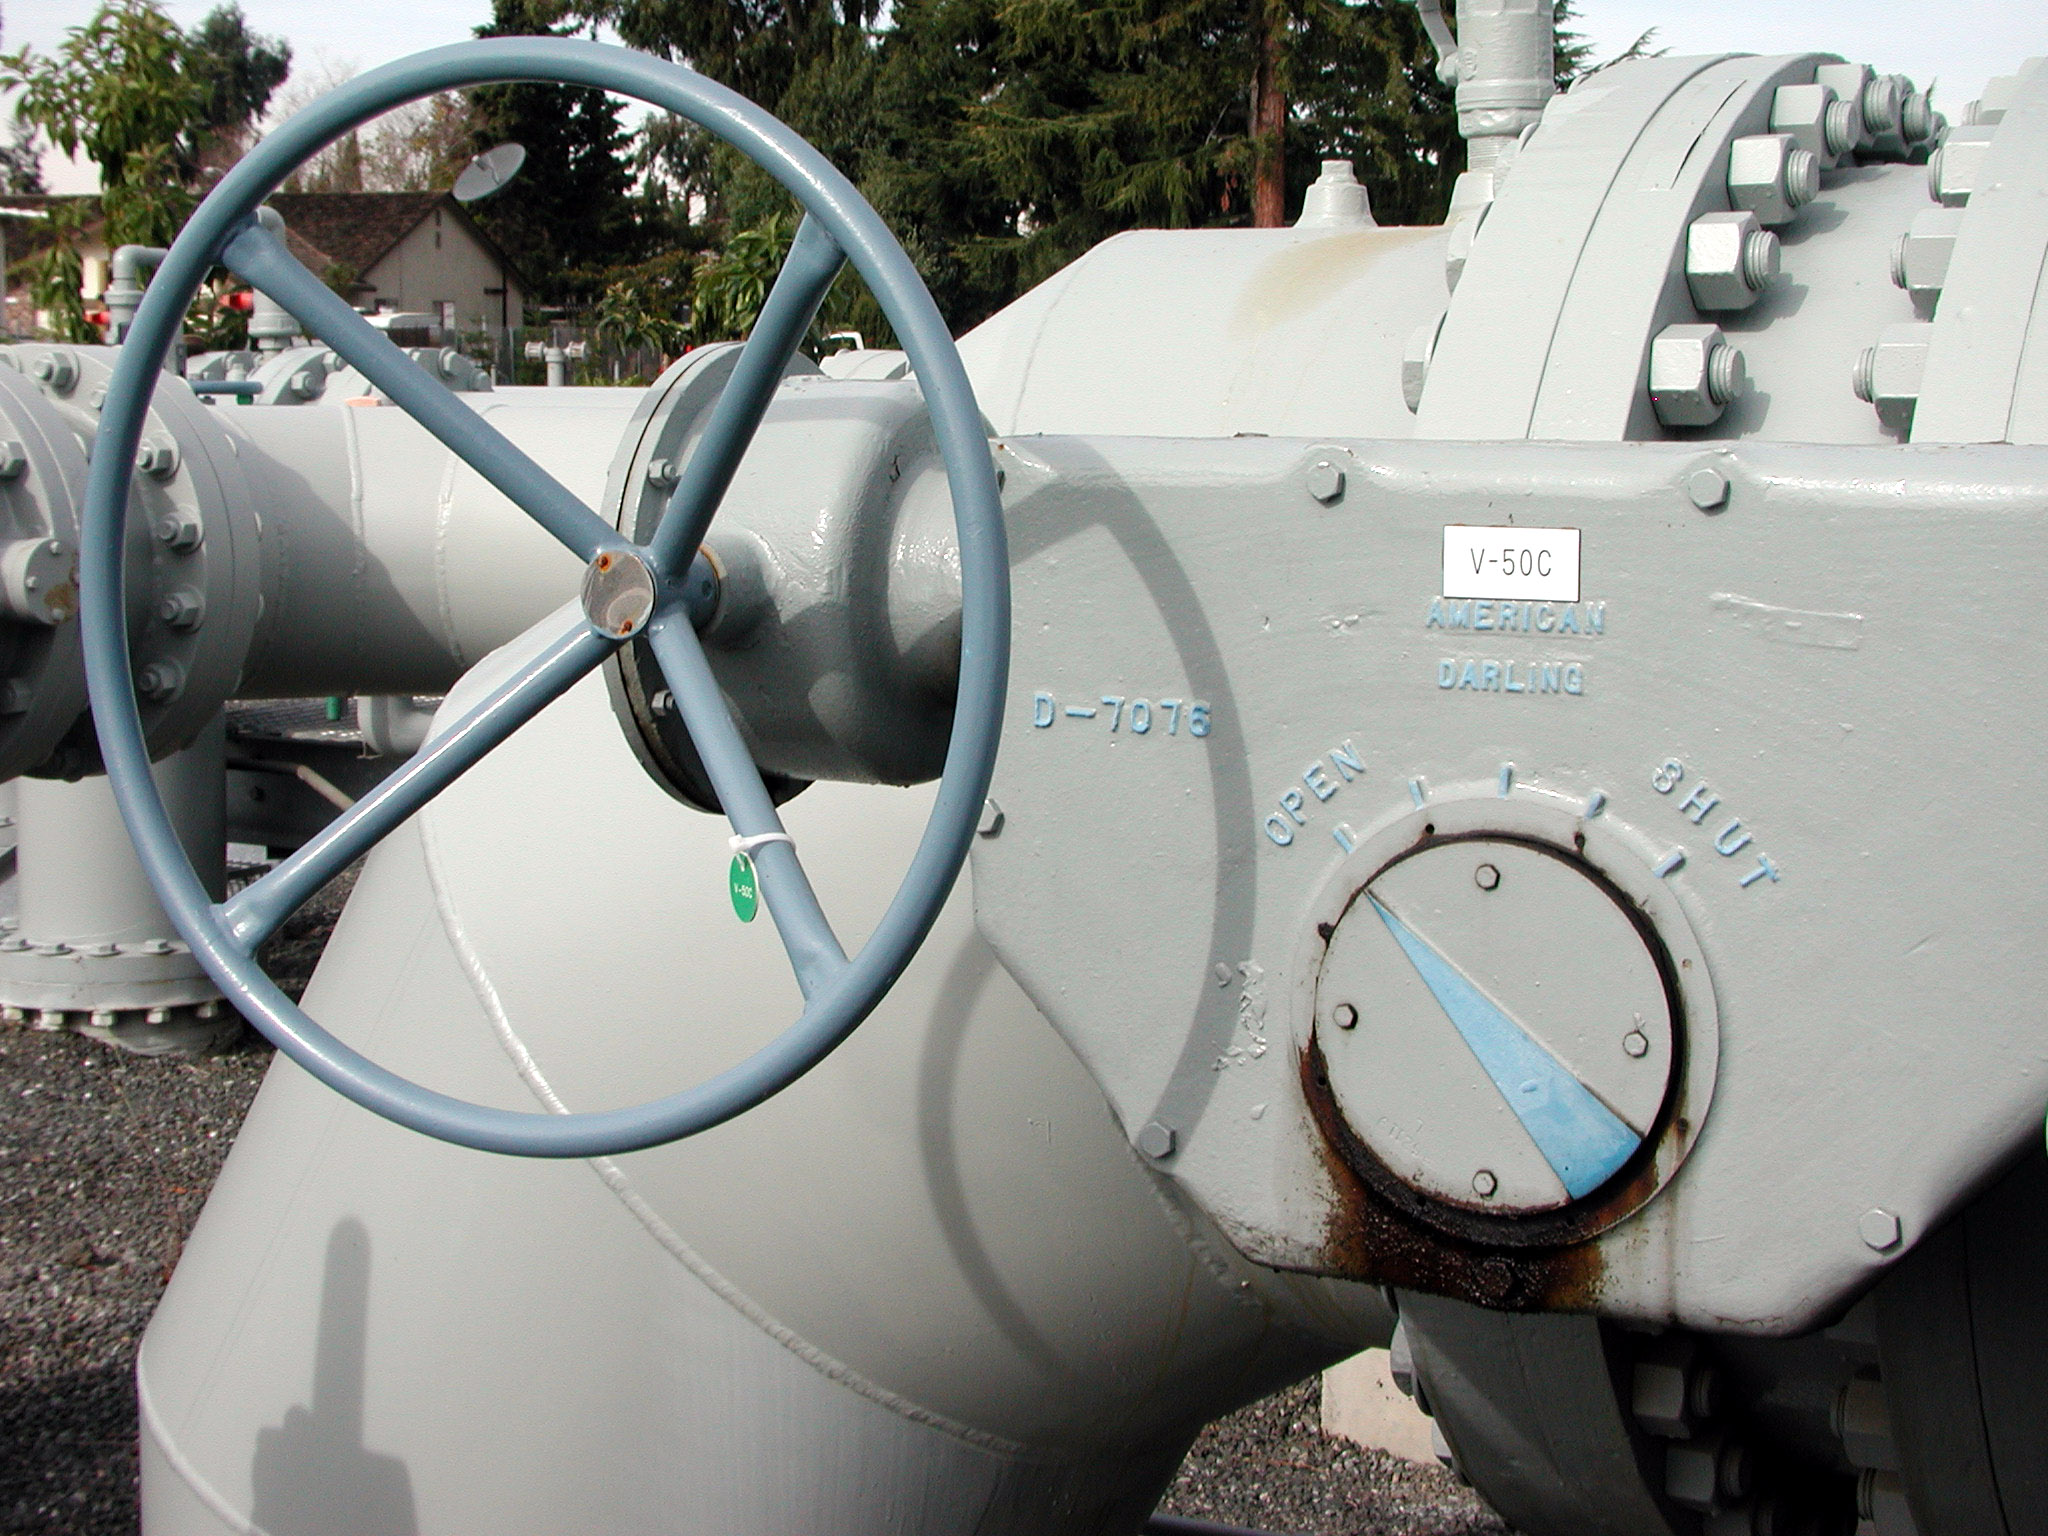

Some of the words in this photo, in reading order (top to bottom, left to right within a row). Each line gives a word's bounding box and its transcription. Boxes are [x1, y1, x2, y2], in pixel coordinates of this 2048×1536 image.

[1470, 549, 1552, 577] V-50C
[1426, 600, 1606, 634] AMERICAN
[1437, 660, 1584, 695] DARLING
[1034, 692, 1212, 736] D-7076
[1264, 742, 1366, 846] OPEN
[1652, 759, 1779, 888] SHUT
